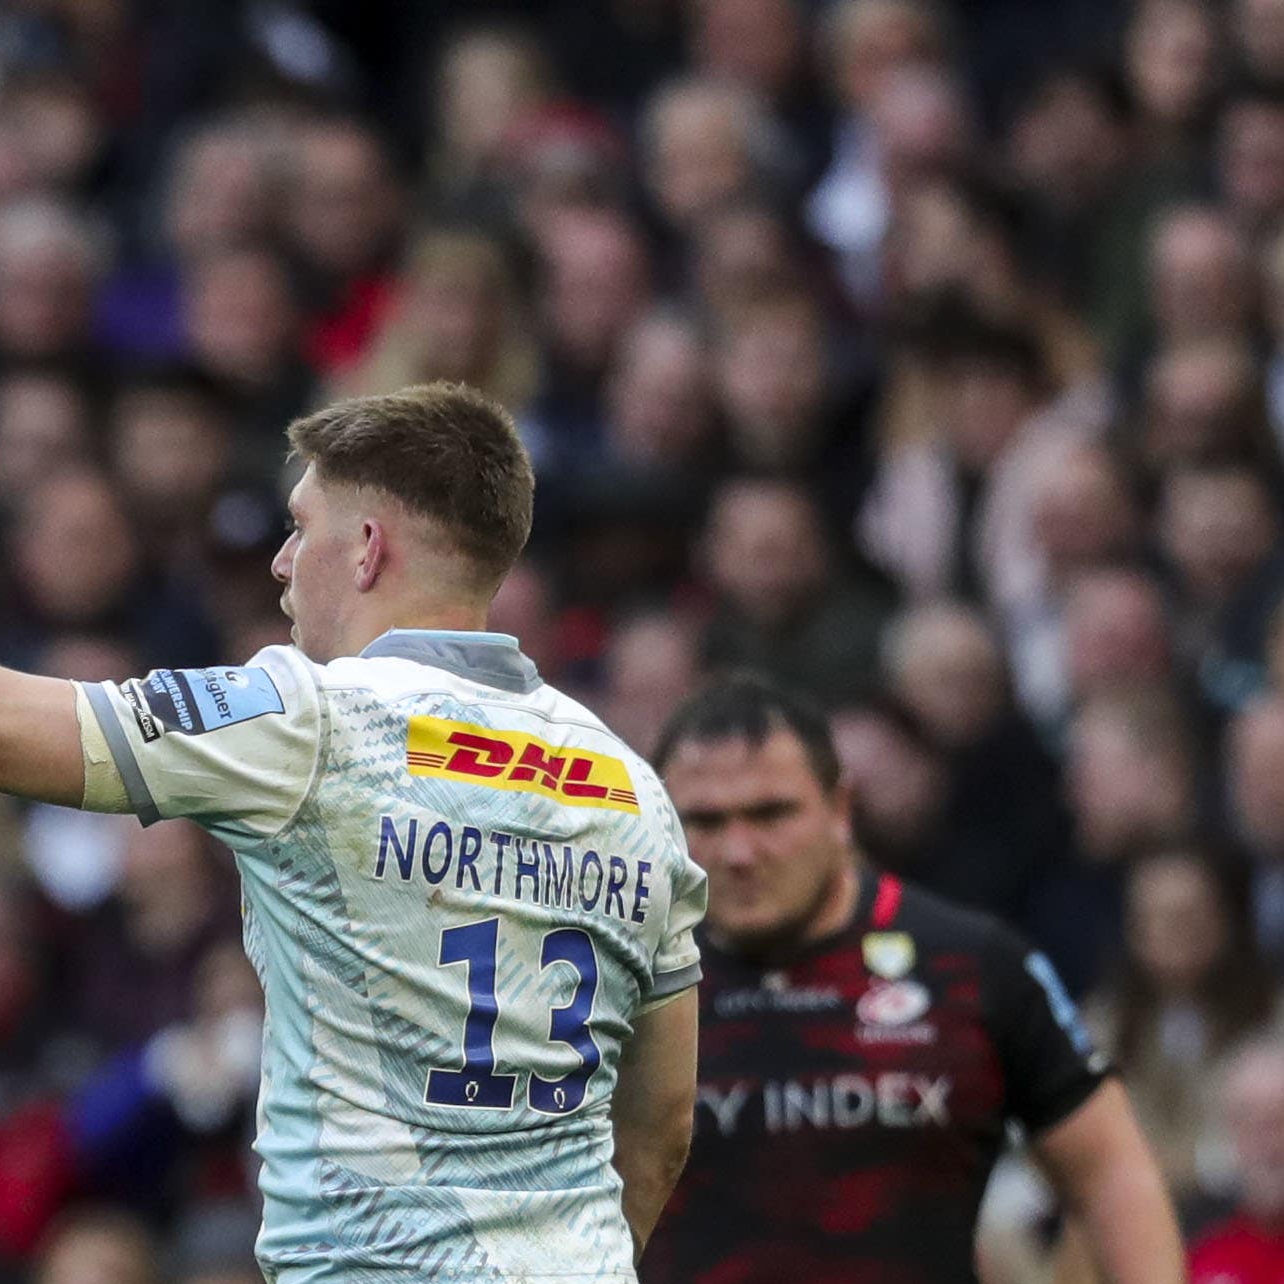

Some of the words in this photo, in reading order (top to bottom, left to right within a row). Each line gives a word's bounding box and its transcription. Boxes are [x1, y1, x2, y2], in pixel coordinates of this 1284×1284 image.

[445, 731, 608, 798] DHL
[374, 813, 653, 925] NORTHMORE
[424, 915, 602, 1117] 13
[763, 1071, 953, 1134] INDEX
